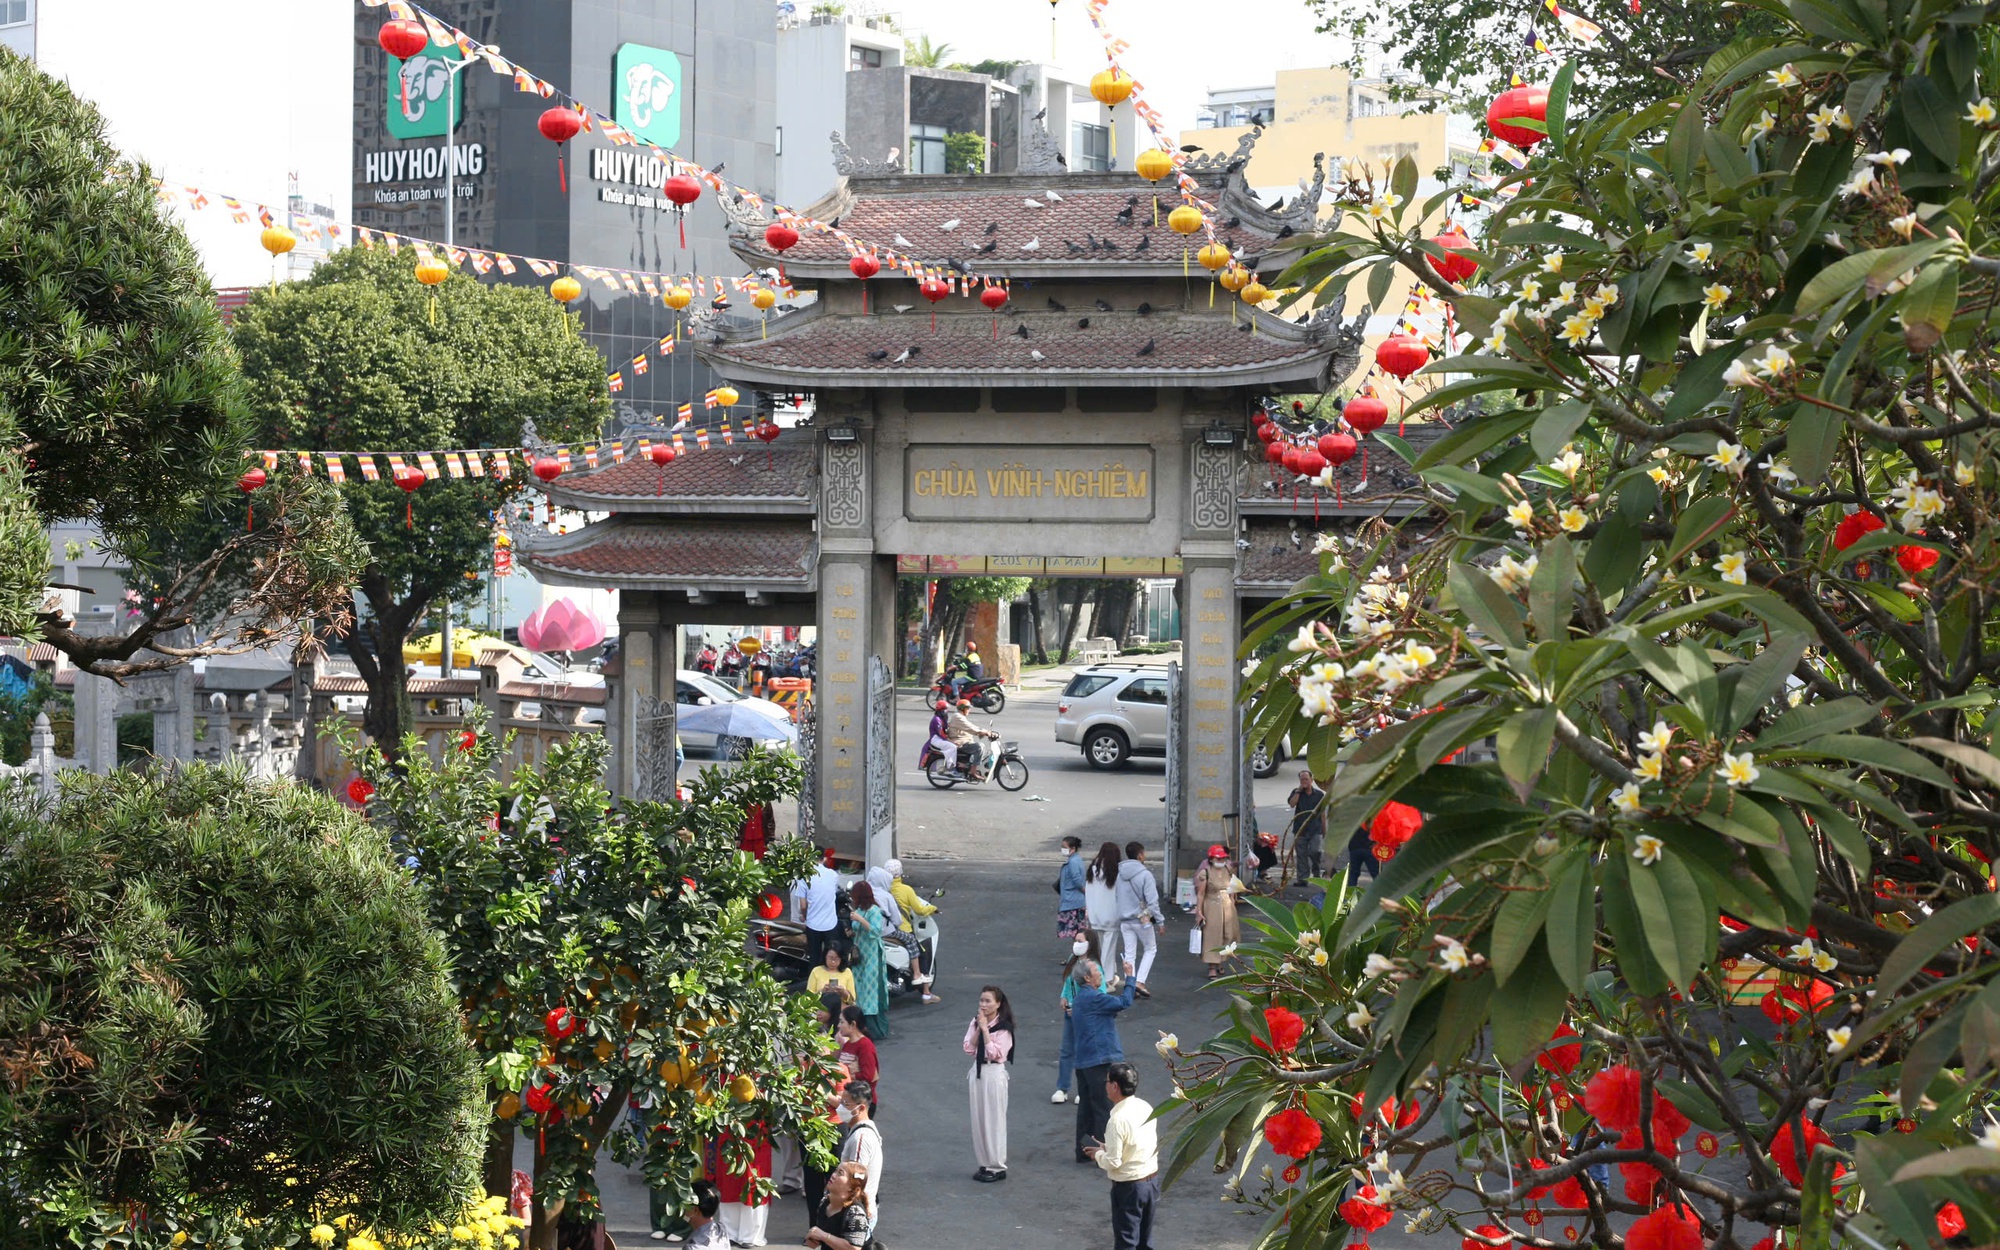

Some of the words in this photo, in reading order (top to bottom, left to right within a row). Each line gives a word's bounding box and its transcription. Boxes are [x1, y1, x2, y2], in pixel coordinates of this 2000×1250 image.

[366, 143, 482, 183] HUYHOANG
[375, 187, 399, 203] Khóa
[398, 190, 409, 201] an
[411, 186, 431, 200] toàn
[457, 182, 474, 200] trội
[602, 187, 623, 203] Khóa
[624, 194, 635, 205] an
[636, 193, 655, 208] toàn
[914, 461, 978, 497] CHÙA
